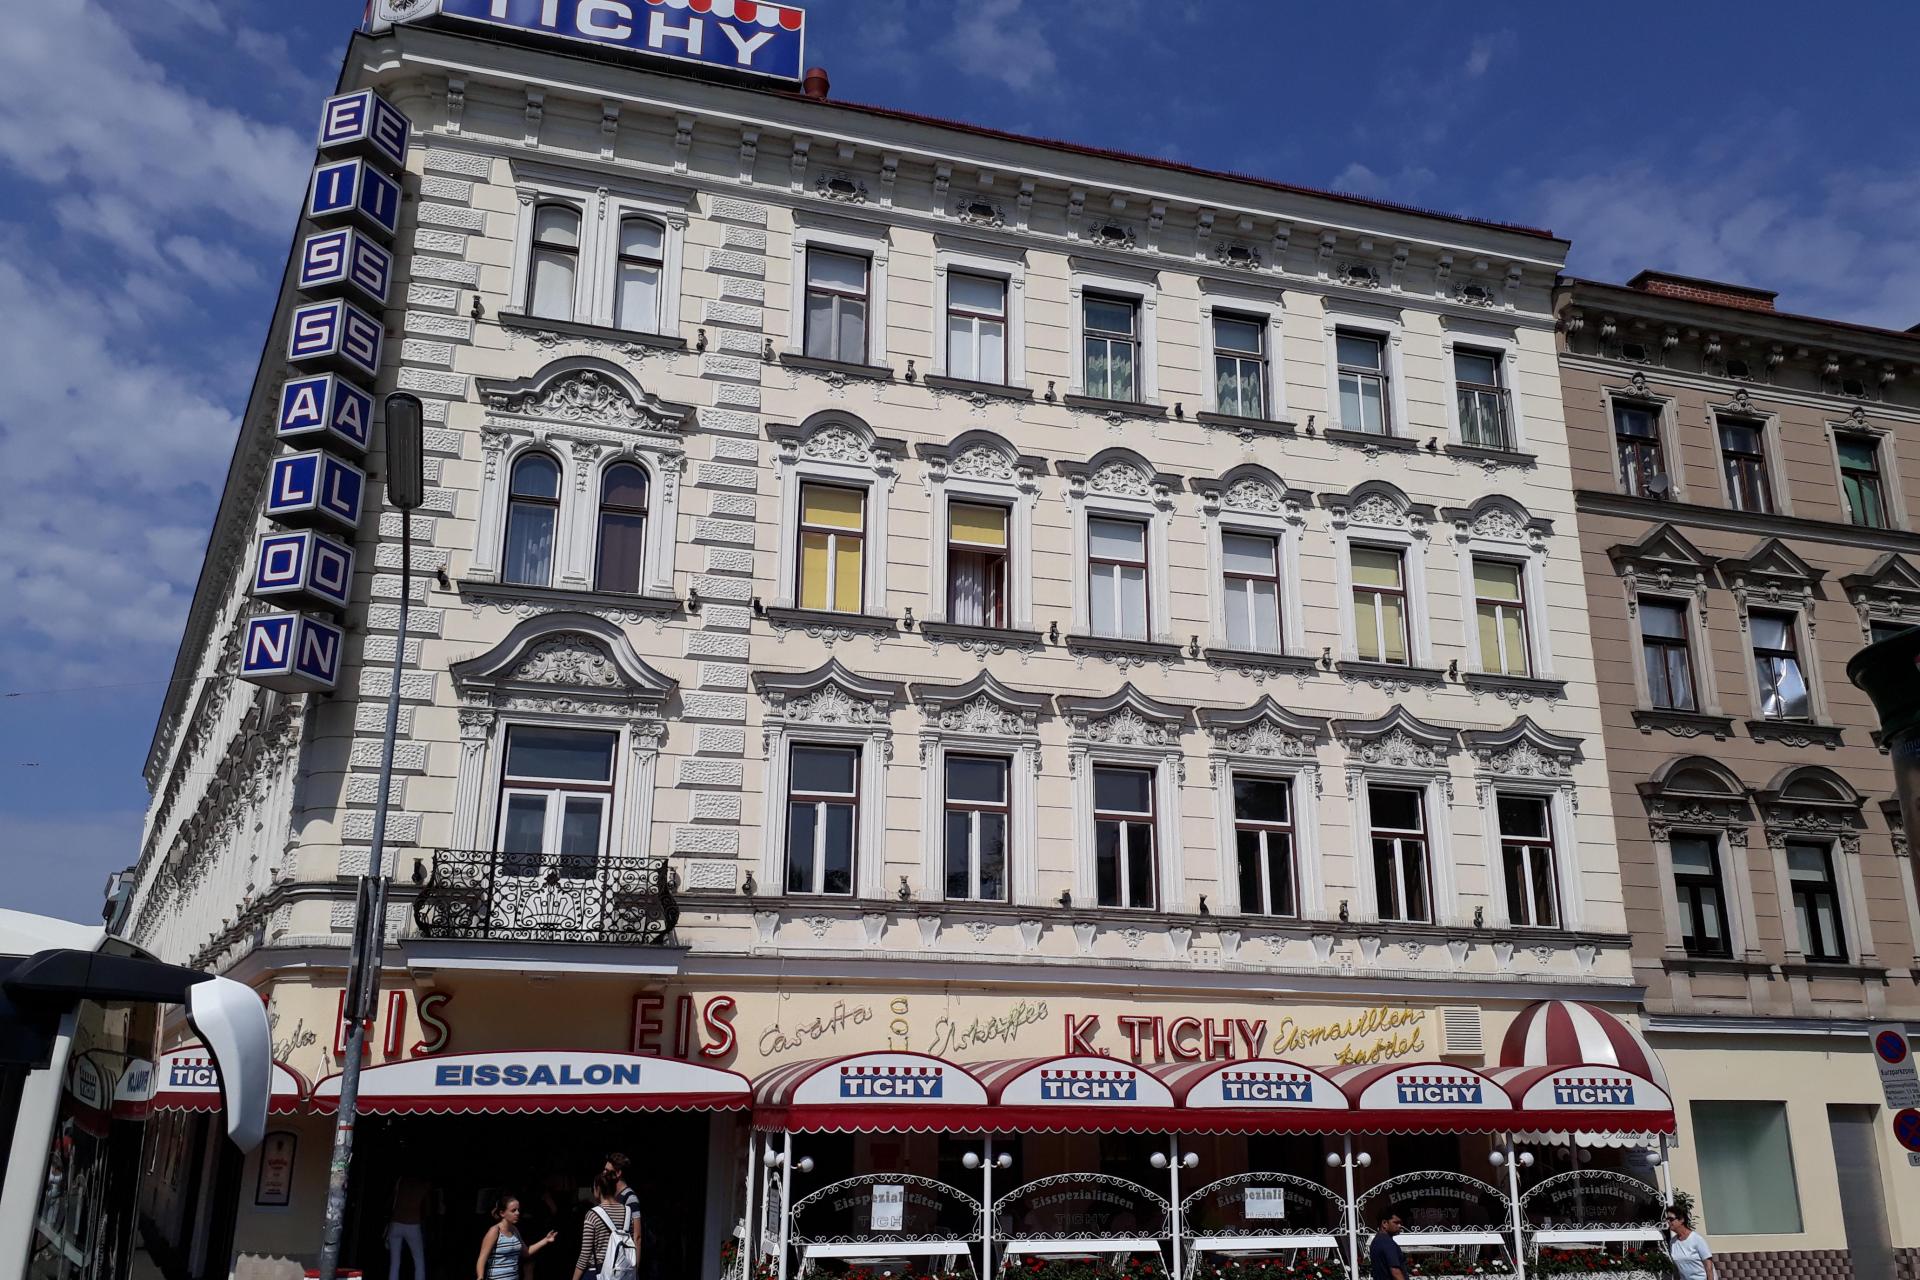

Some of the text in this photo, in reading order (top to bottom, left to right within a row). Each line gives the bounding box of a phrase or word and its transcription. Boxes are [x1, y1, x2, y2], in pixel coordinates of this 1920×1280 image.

[249, 100, 362, 665] EISSALON
[302, 104, 403, 674] EISSALON
[629, 991, 737, 1059] EIS
[1117, 1013, 1267, 1059] TICHY
[173, 1069, 218, 1086] TIC
[435, 1063, 641, 1086] EISSALON
[844, 1078, 938, 1096] TICHY
[1044, 1081, 1131, 1098] TICHY
[1225, 1084, 1309, 1100] TICHY
[1400, 1086, 1478, 1102] TICHY
[1556, 1088, 1629, 1103] TICHY
[834, 1191, 943, 1212] Eisspezialitäten
[1032, 1189, 1134, 1209] Eisspezialitäten
[1550, 1184, 1636, 1203] Eisspezialitäten
